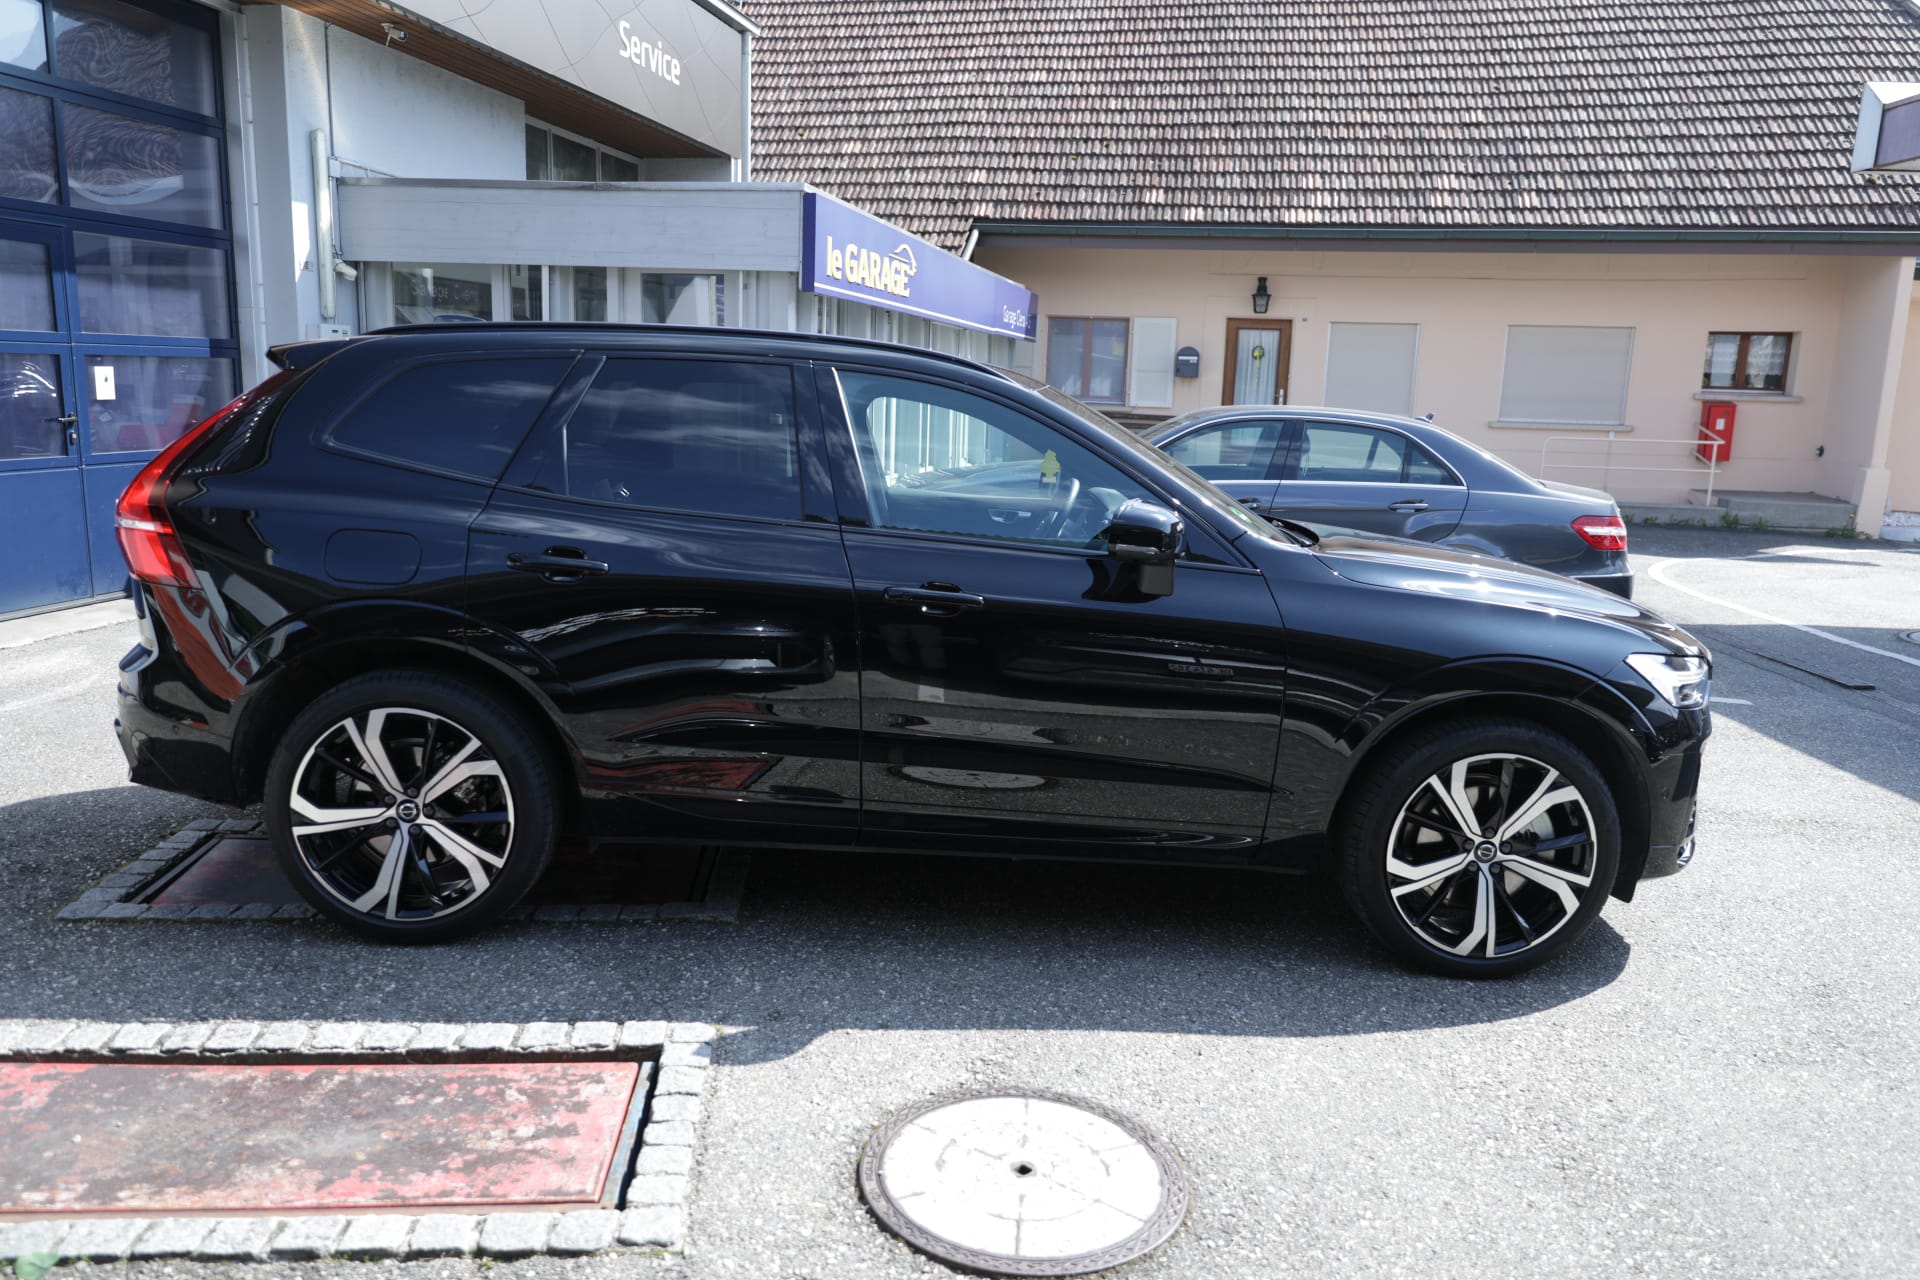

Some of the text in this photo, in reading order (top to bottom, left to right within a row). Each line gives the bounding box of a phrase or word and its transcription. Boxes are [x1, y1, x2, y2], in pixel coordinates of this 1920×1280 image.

[619, 20, 681, 86] Service
[825, 234, 911, 298] le GARAGE
